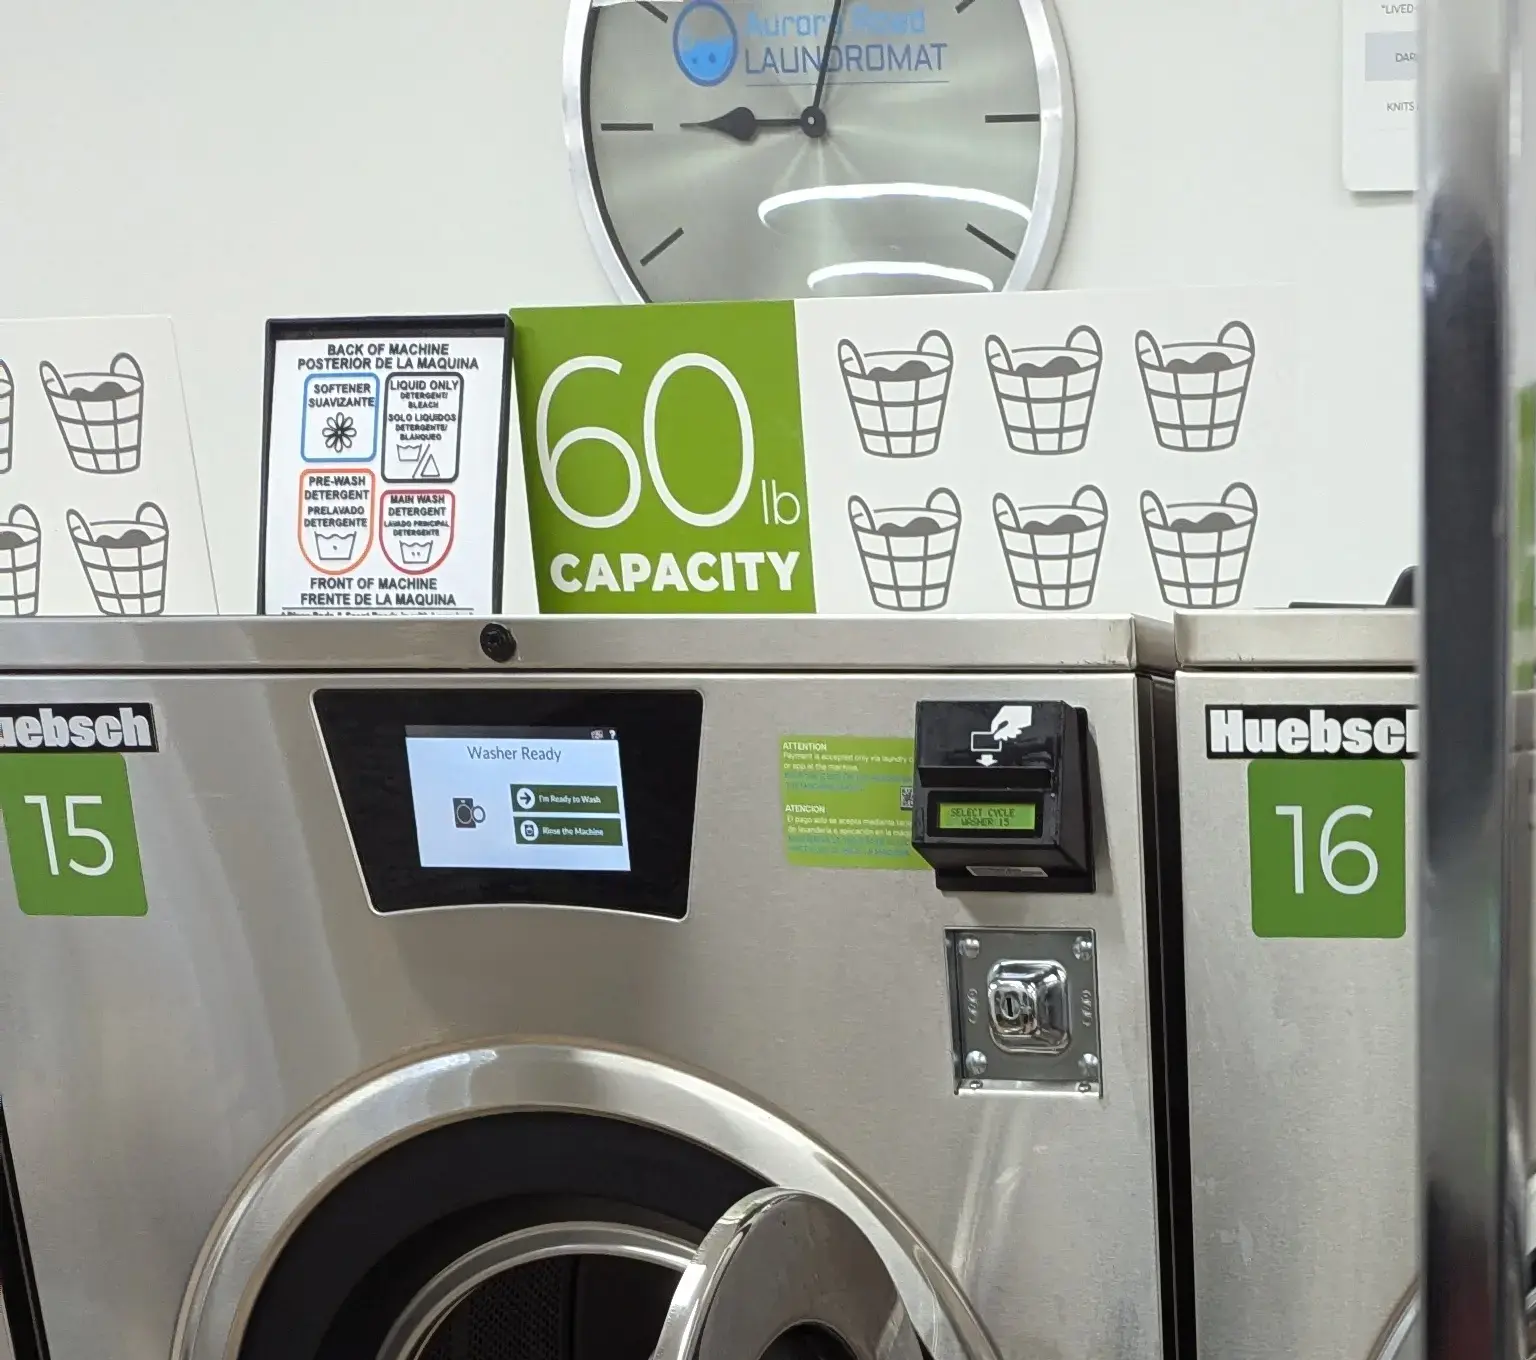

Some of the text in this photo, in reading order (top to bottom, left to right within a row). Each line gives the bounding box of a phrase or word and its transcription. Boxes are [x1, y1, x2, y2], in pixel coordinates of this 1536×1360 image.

[745, 43, 948, 74] LAUNDROMAT
[1395, 52, 1418, 63] DAR
[1386, 101, 1415, 112] KNITS
[327, 343, 449, 356] BACK OF MACHINE
[298, 357, 479, 370] POSTERIOR DE LA MAQUINA
[313, 383, 371, 394] SOFTENER
[390, 380, 459, 391] LIQUID ONLY
[308, 396, 375, 408] SUAVIZANTE
[408, 401, 439, 409] BLEACH
[388, 413, 412, 422] SOLO
[536, 353, 754, 528] 60
[308, 476, 366, 487] PRE-WASH
[304, 490, 369, 500] DETERGENT
[390, 494, 445, 504] MAIN WASH
[761, 479, 800, 525] lb
[307, 506, 365, 515] PRELAVADO
[388, 507, 447, 516] DETERGENT
[304, 518, 368, 527] DETERGENTE
[550, 551, 800, 593] CAPACITY
[310, 578, 438, 590] FRONT OF MACHINE
[300, 593, 456, 606] FRENTE DE LA MAQUINA
[782, 742, 827, 751] ATTENTION
[466, 746, 562, 763] Washer Ready
[550, 794, 571, 804] Ready
[572, 795, 580, 803] to
[785, 804, 825, 813] ATENCION
[950, 808, 1016, 817] SELECT CYCLE
[961, 818, 1010, 827] WASHER 15
[24, 795, 114, 876] 15
[1275, 804, 1379, 895] 16
